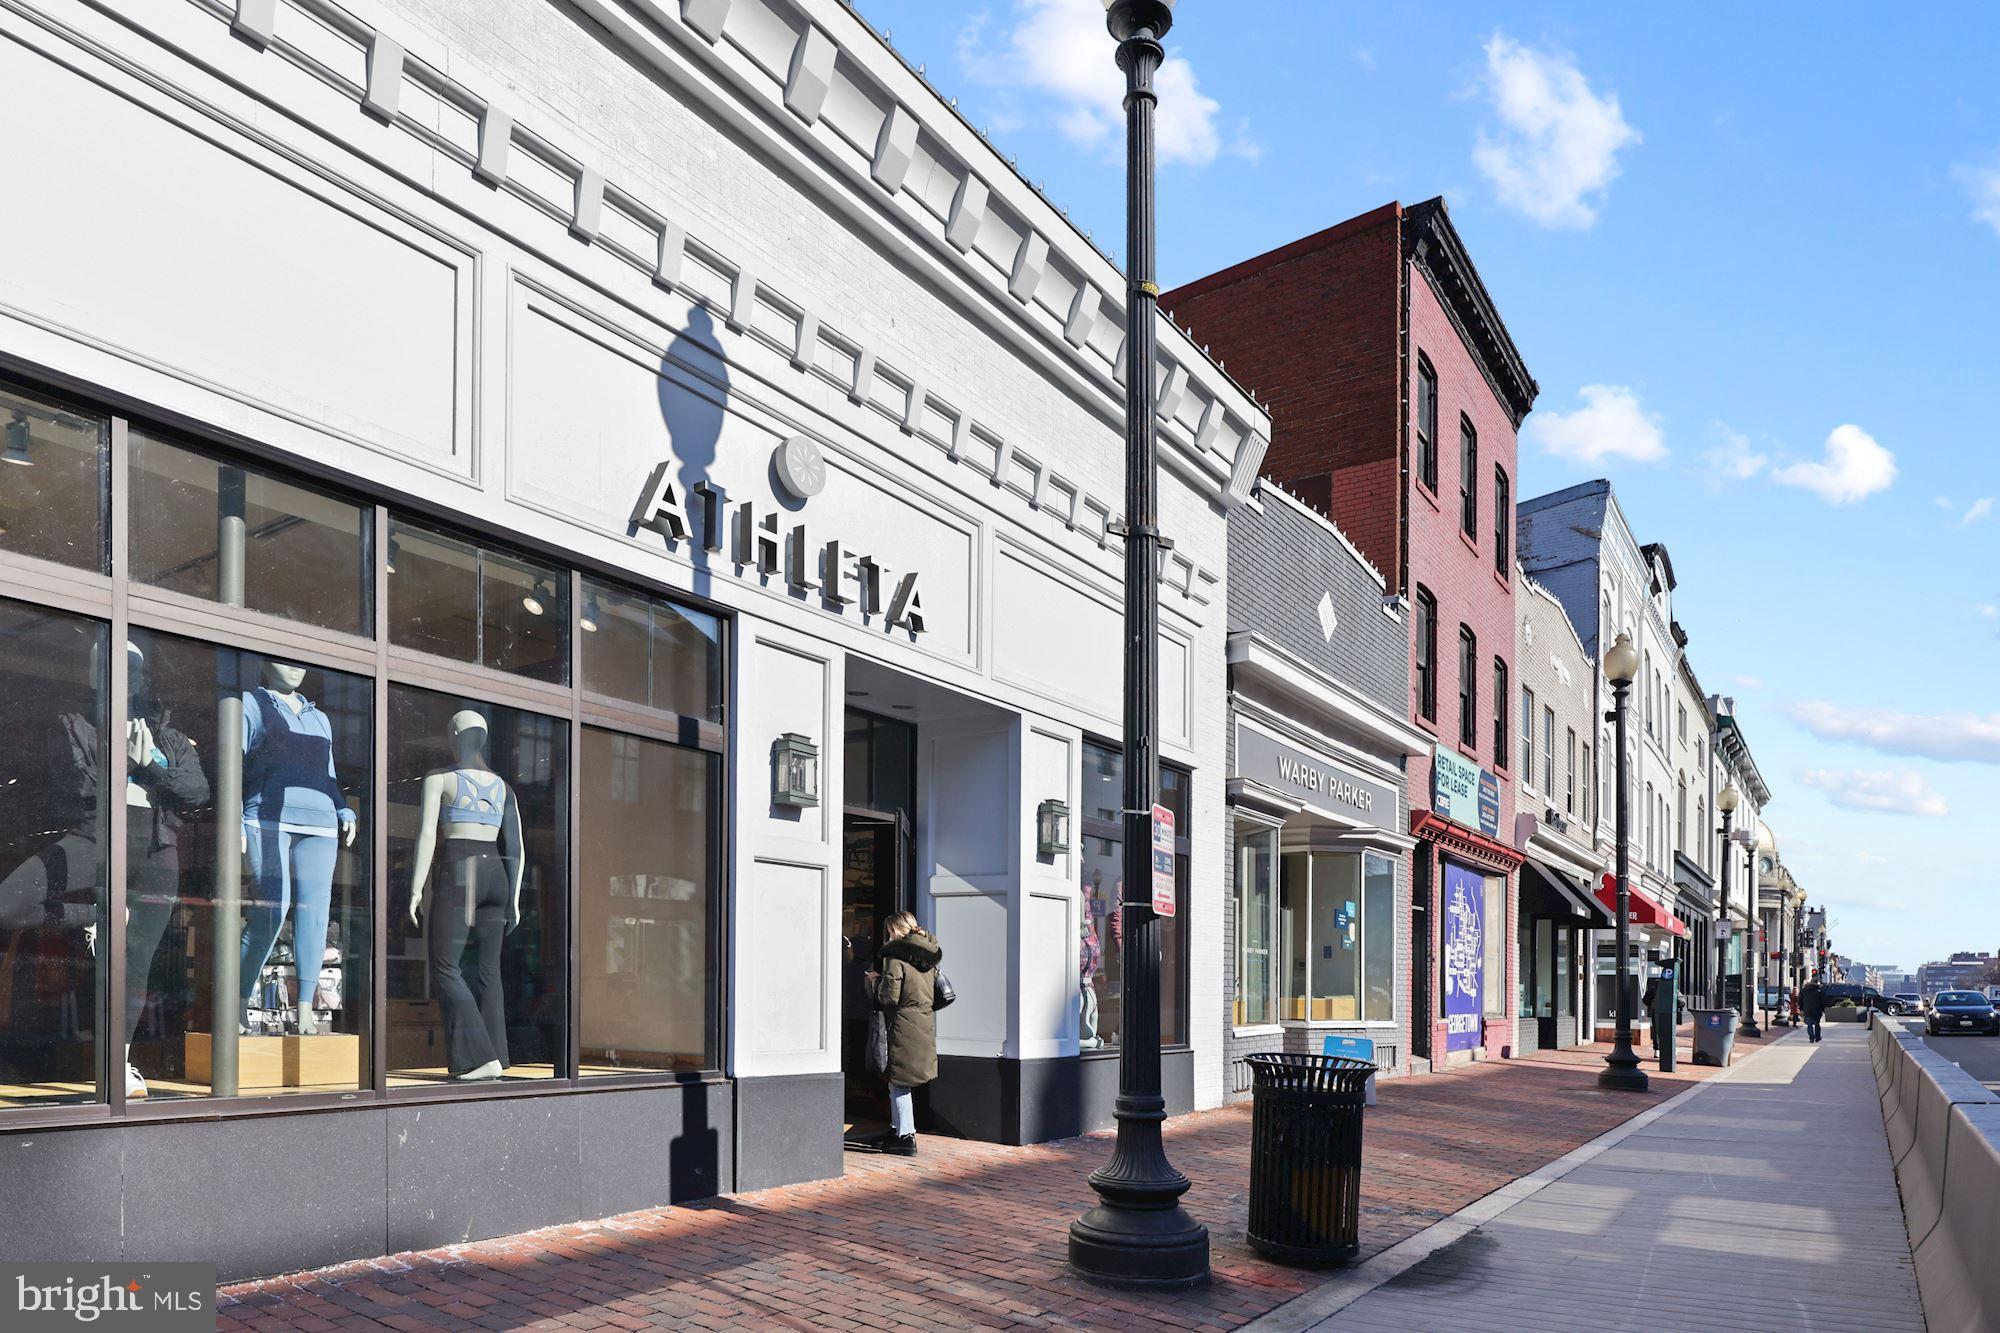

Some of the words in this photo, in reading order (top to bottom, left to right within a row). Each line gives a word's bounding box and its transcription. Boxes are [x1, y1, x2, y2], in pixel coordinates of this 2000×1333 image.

[628, 460, 929, 634] ATHLETA
[1277, 755, 1325, 792] WARBY
[1328, 777, 1373, 812] PARKER
[1437, 754, 1457, 776] RETAIL
[1458, 766, 1475, 786] SPACE
[1437, 771, 1450, 790] FOR
[1450, 780, 1468, 798] LEASE
[1665, 968, 1673, 979] P
[1448, 1013, 1479, 1034] GEORGETOWN
